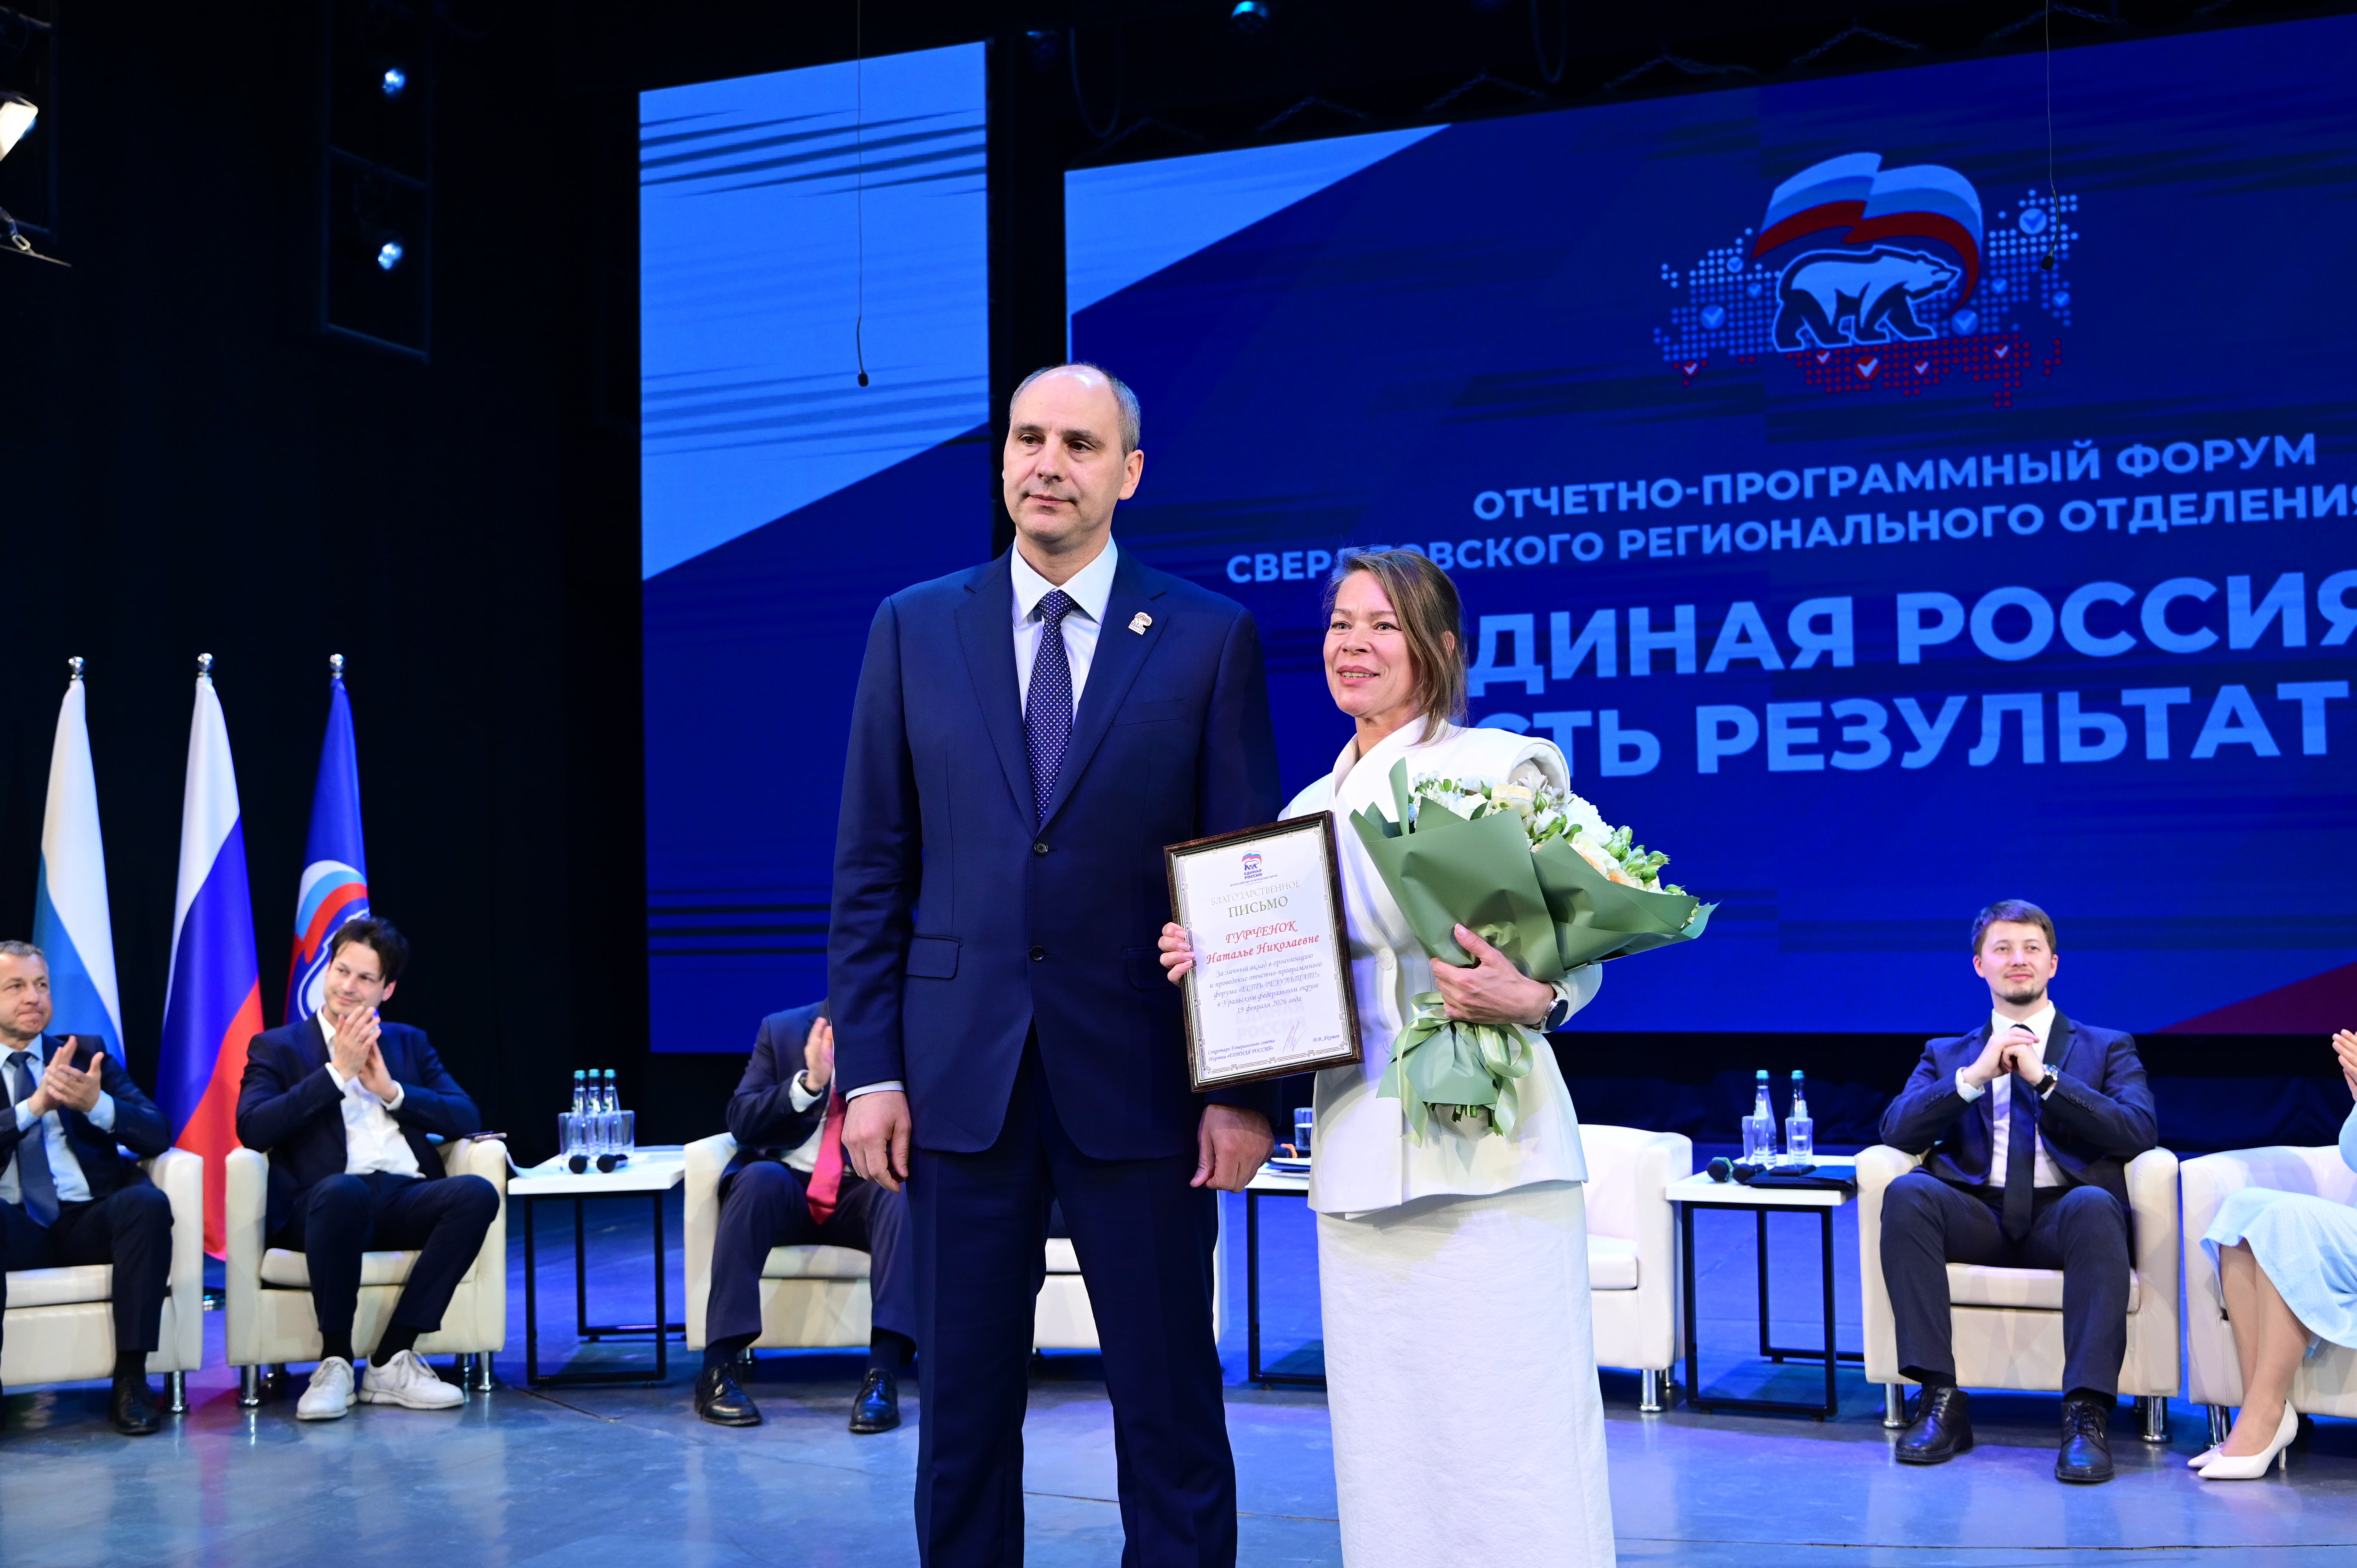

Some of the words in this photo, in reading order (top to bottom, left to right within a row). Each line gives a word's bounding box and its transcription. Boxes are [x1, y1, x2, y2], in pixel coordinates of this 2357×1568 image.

[1474, 440, 2099, 520] ОТЧЕТНО-ПРОГРАММНЫЙ
[2117, 433, 2315, 477] ФОРУМ
[1227, 532, 1603, 583] СВЕРВСКОГО
[1619, 504, 2044, 559] РЕГИОНАЛЬНОГО
[2060, 484, 2357, 534] ОТДЕЛЕНИ
[1467, 596, 1853, 697] ДИНАЯ
[1696, 681, 2348, 773] РЕЗУЛЬТАТ
[1211, 880, 1300, 905] БЛАГОДАРСТВЕННОЕ
[1228, 896, 1288, 918] ПИСЬМО
[1226, 920, 1298, 943] ГУРЧЕНОК
[1206, 948, 1253, 964] Наталье
[1257, 935, 1319, 954] Николаевне
[1215, 977, 1247, 989] проведение
[1249, 962, 1322, 980] отчётно-программного
[1225, 965, 1248, 975] личный
[1250, 961, 1267, 971] вклад
[1273, 954, 1313, 967] организацию
[1214, 989, 1237, 1000] форума
[1239, 982, 1263, 992] «ЕСТЬ
[1264, 971, 1320, 987] РЕЗУЛЬТАТ!»
[1222, 995, 1256, 1007] Уральском
[1258, 987, 1297, 1001] федеральном
[1299, 983, 1319, 992] округе
[1246, 1003, 1270, 1014] февраля
[1272, 998, 1287, 1007] 2026
[1288, 995, 1302, 1003] года
[1231, 1042, 1260, 1051] Генерального
